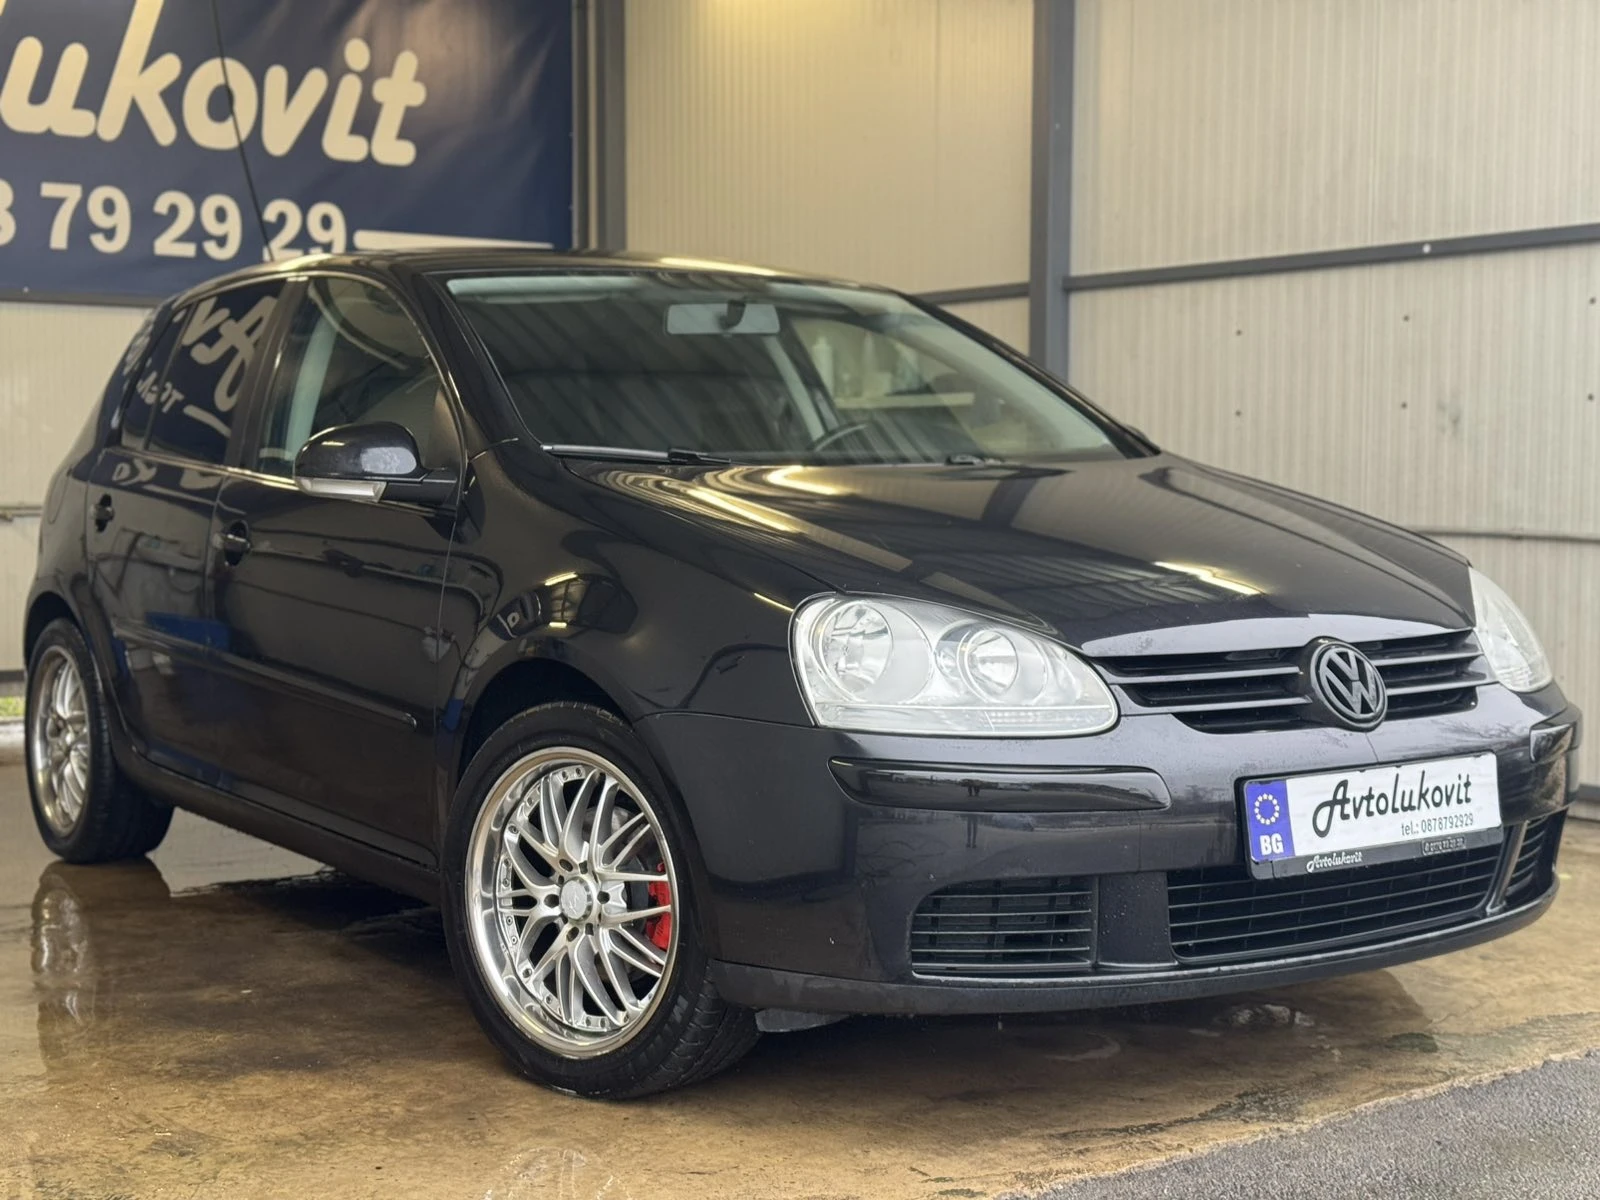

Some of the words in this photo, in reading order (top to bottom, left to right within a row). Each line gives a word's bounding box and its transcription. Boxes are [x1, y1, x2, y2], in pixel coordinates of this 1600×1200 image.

[0, 0, 427, 167] ukovit
[40, 181, 132, 254] 79
[152, 190, 243, 261] 29
[262, 198, 347, 262] 29
[1318, 645, 1383, 720] VW
[1312, 770, 1472, 838] Avtolukovit
[1401, 820, 1419, 836] tel.:
[1421, 812, 1474, 833] 0878792929
[1260, 832, 1284, 856] BG
